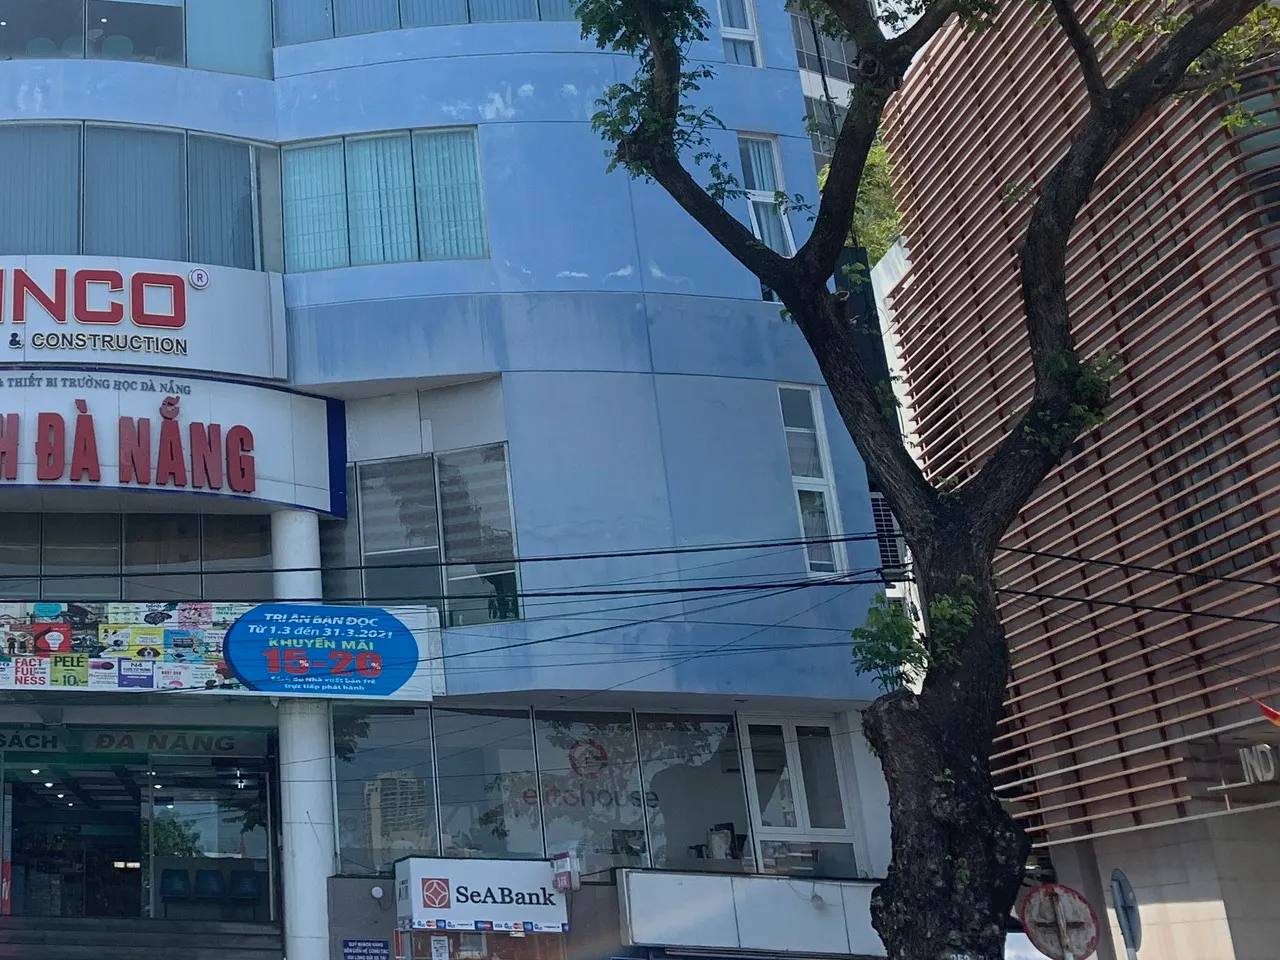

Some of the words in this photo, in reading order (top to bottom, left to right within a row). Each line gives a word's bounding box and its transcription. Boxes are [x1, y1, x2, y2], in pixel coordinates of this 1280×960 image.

[8, 332, 23, 348] &
[31, 333, 189, 355] CONSTRUCTION
[7, 372, 43, 388] THIẾT
[61, 375, 111, 390] TRƯỜNG
[113, 380, 138, 393] HỌC
[140, 379, 157, 393] ĐÀ
[35, 398, 101, 482] ĐÀ
[118, 396, 257, 493] NẴNG
[312, 615, 344, 626] BẠN
[345, 617, 379, 628] ĐỌC
[248, 624, 265, 634] Từ
[270, 626, 291, 635] 1.3
[294, 627, 320, 636] đến
[268, 637, 336, 649] KHUYẾN
[341, 640, 374, 651] MÃI
[14, 658, 43, 667] FACT
[54, 654, 85, 668] PELÉ
[14, 667, 35, 676] FUL
[14, 676, 46, 685] NESS
[455, 885, 557, 907] SeABank
